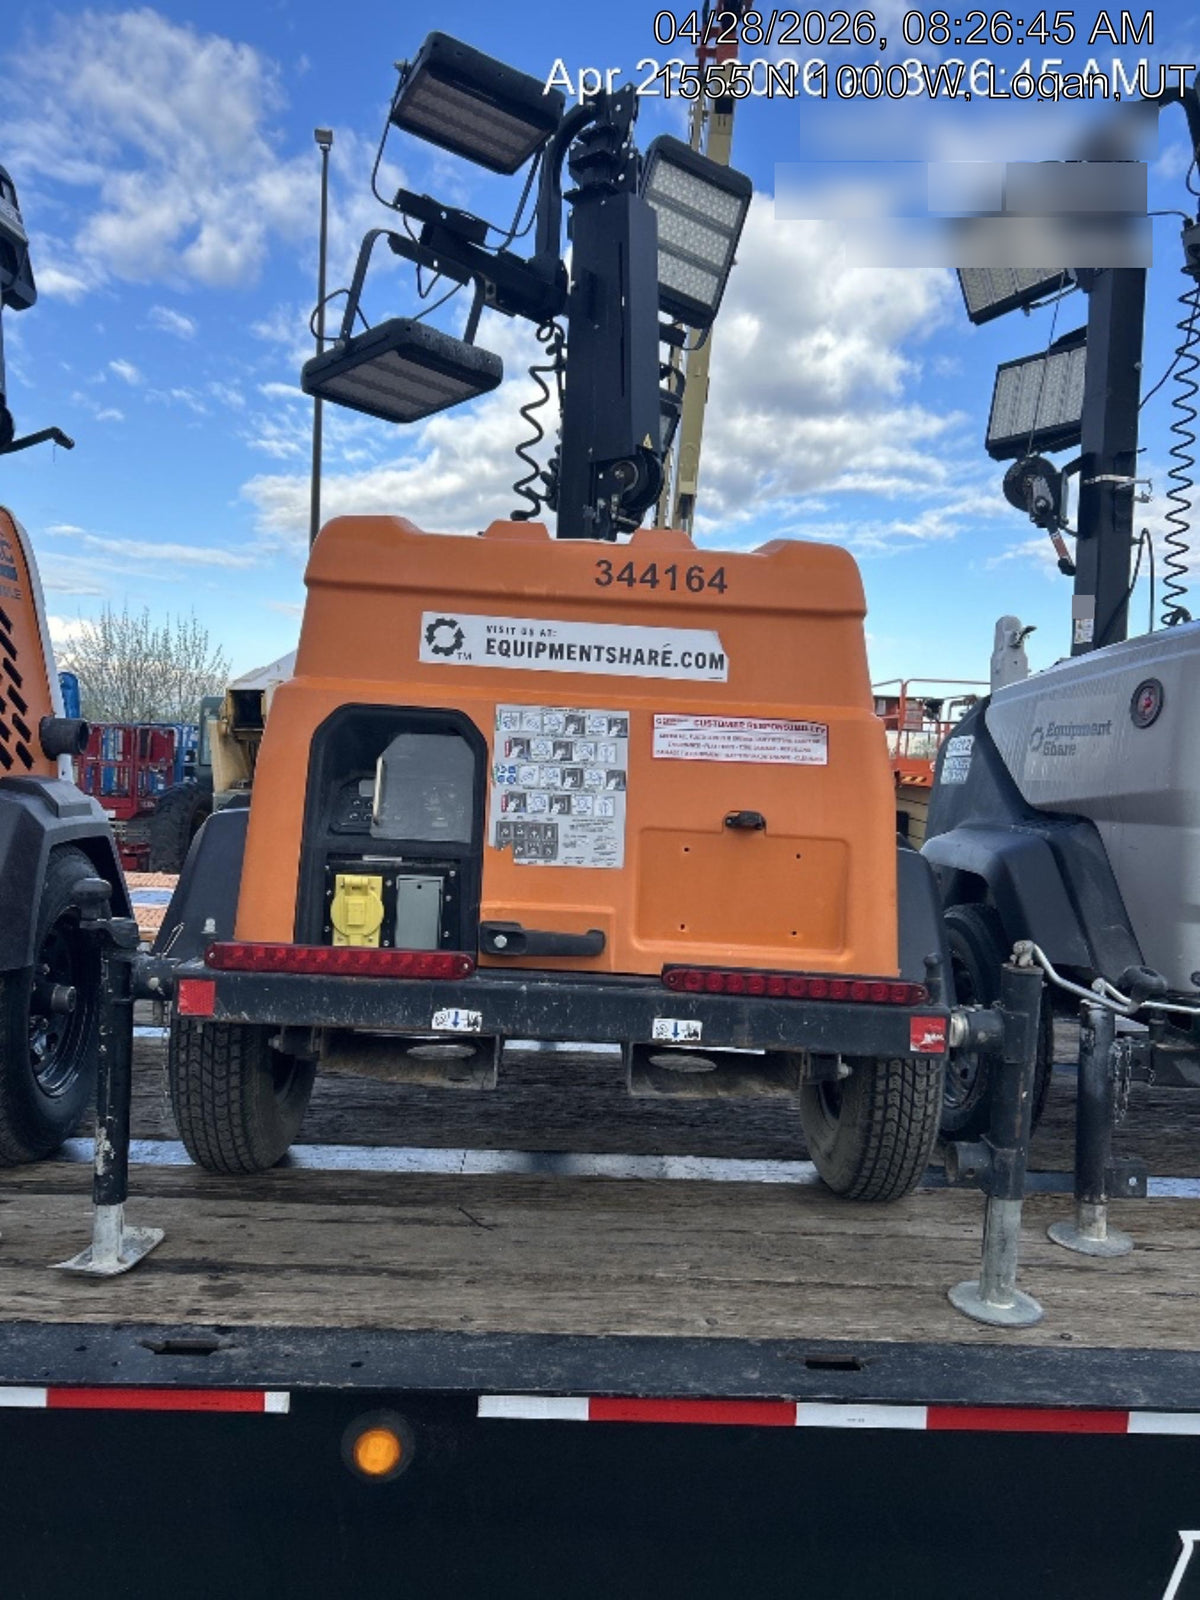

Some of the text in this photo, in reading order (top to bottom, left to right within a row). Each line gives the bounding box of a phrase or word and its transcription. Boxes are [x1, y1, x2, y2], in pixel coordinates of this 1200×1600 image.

[594, 559, 728, 594] 344164
[486, 625, 516, 636] VISIT
[485, 637, 725, 671] EQUIPMENTSHARE.COM
[1046, 719, 1113, 740] Equipment
